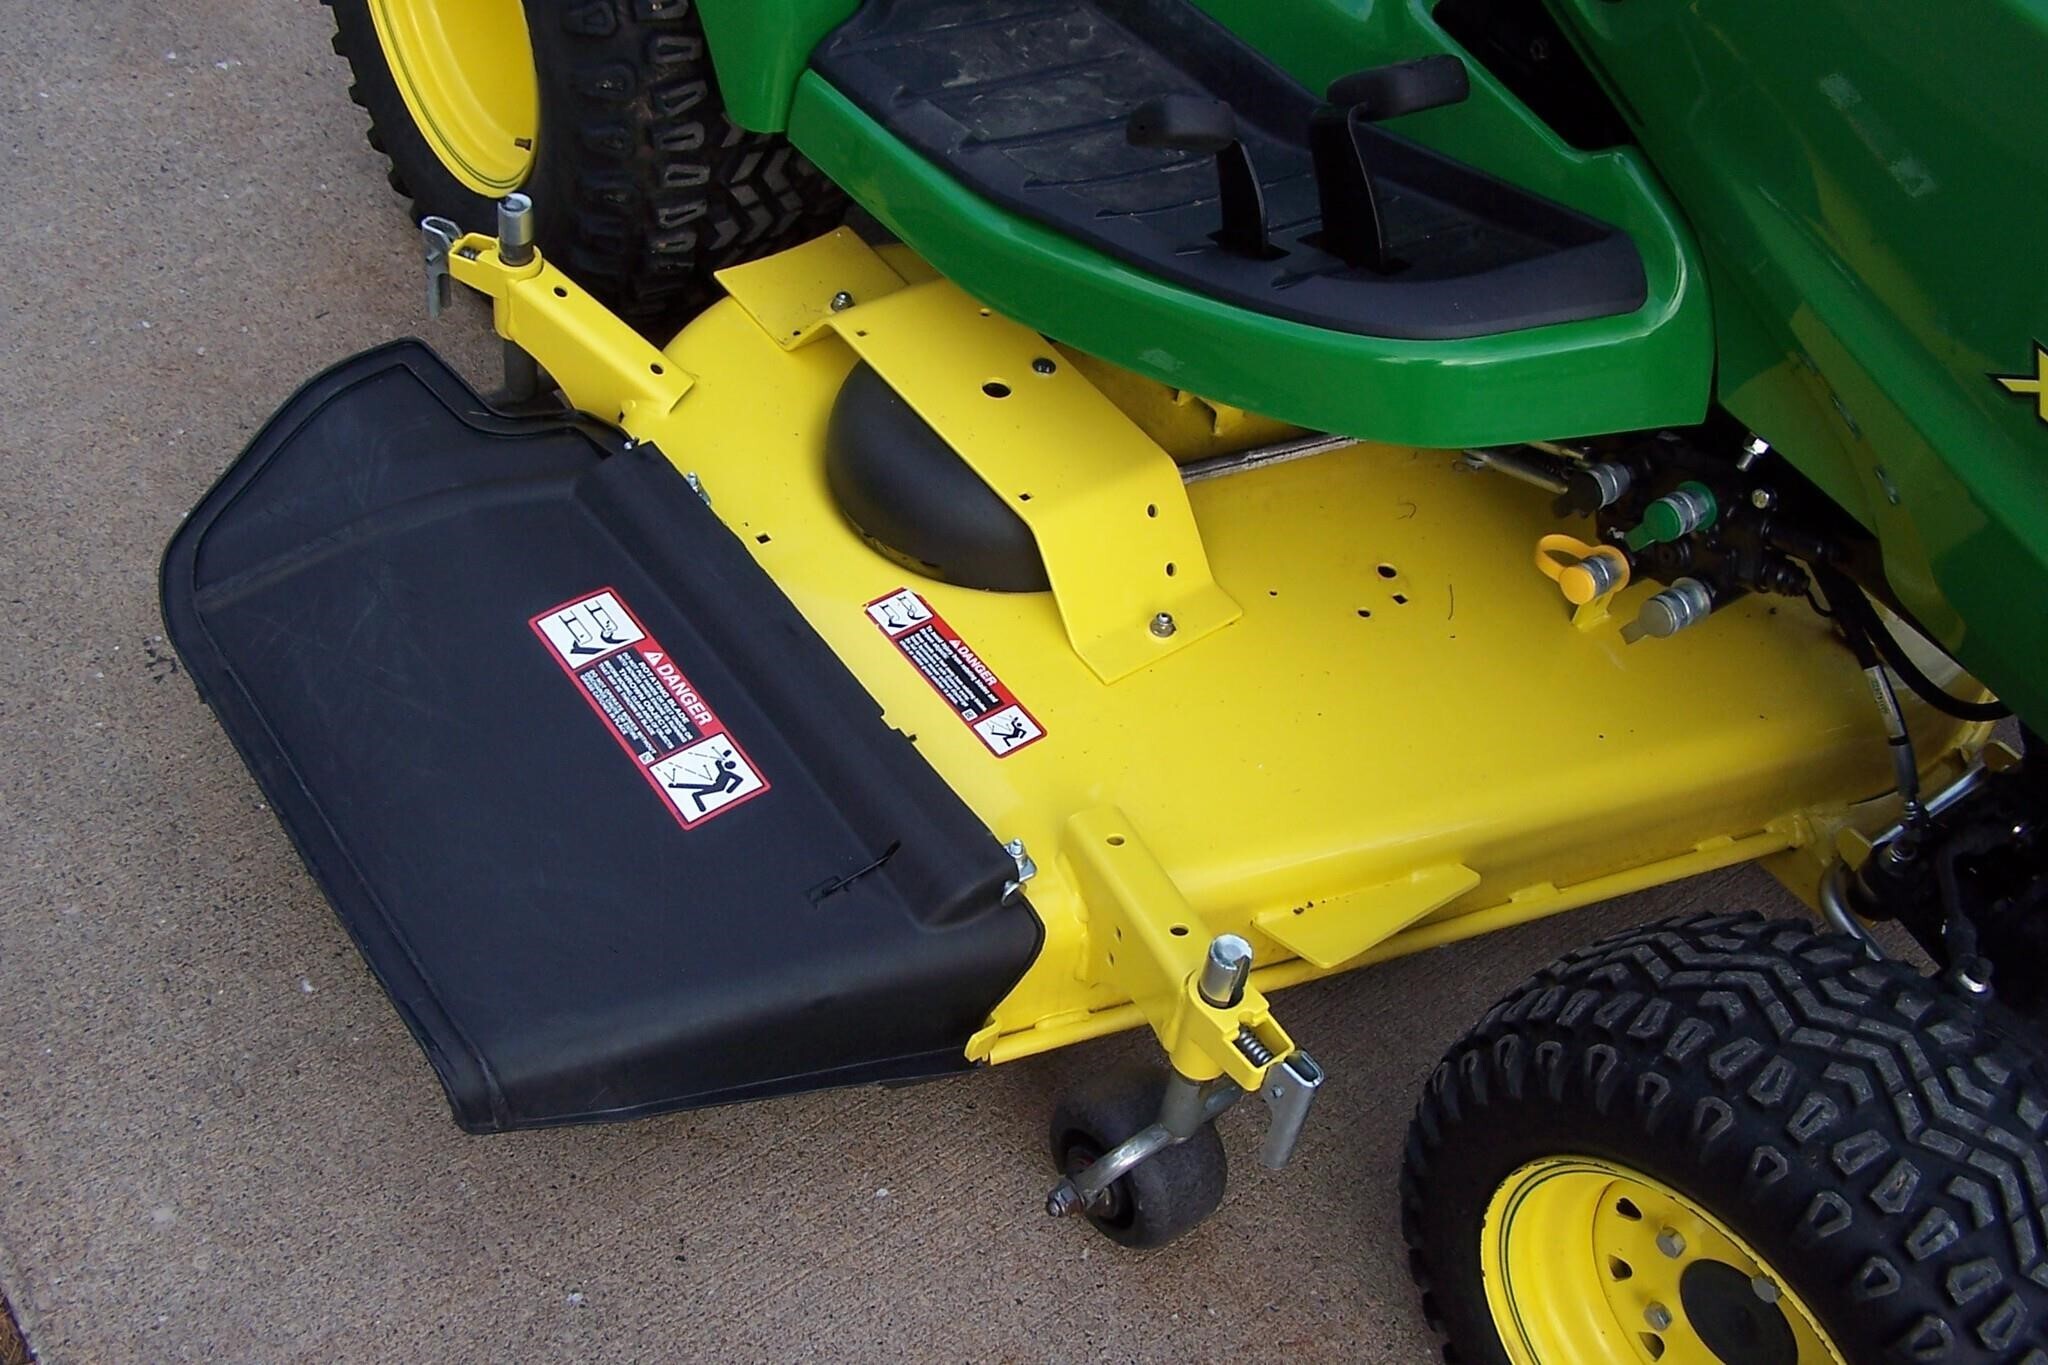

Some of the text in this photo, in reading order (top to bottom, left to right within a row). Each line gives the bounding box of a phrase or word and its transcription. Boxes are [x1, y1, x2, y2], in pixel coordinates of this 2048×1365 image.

[621, 651, 631, 660] DO
[627, 659, 639, 670] NOT
[635, 669, 646, 679] PUT
[661, 702, 674, 715] FEET
[637, 661, 689, 723] ROTATING BLADE
[655, 662, 714, 726] DANGER
[955, 645, 998, 686] DANGER
[617, 667, 673, 735] THROWN OBJECTS
